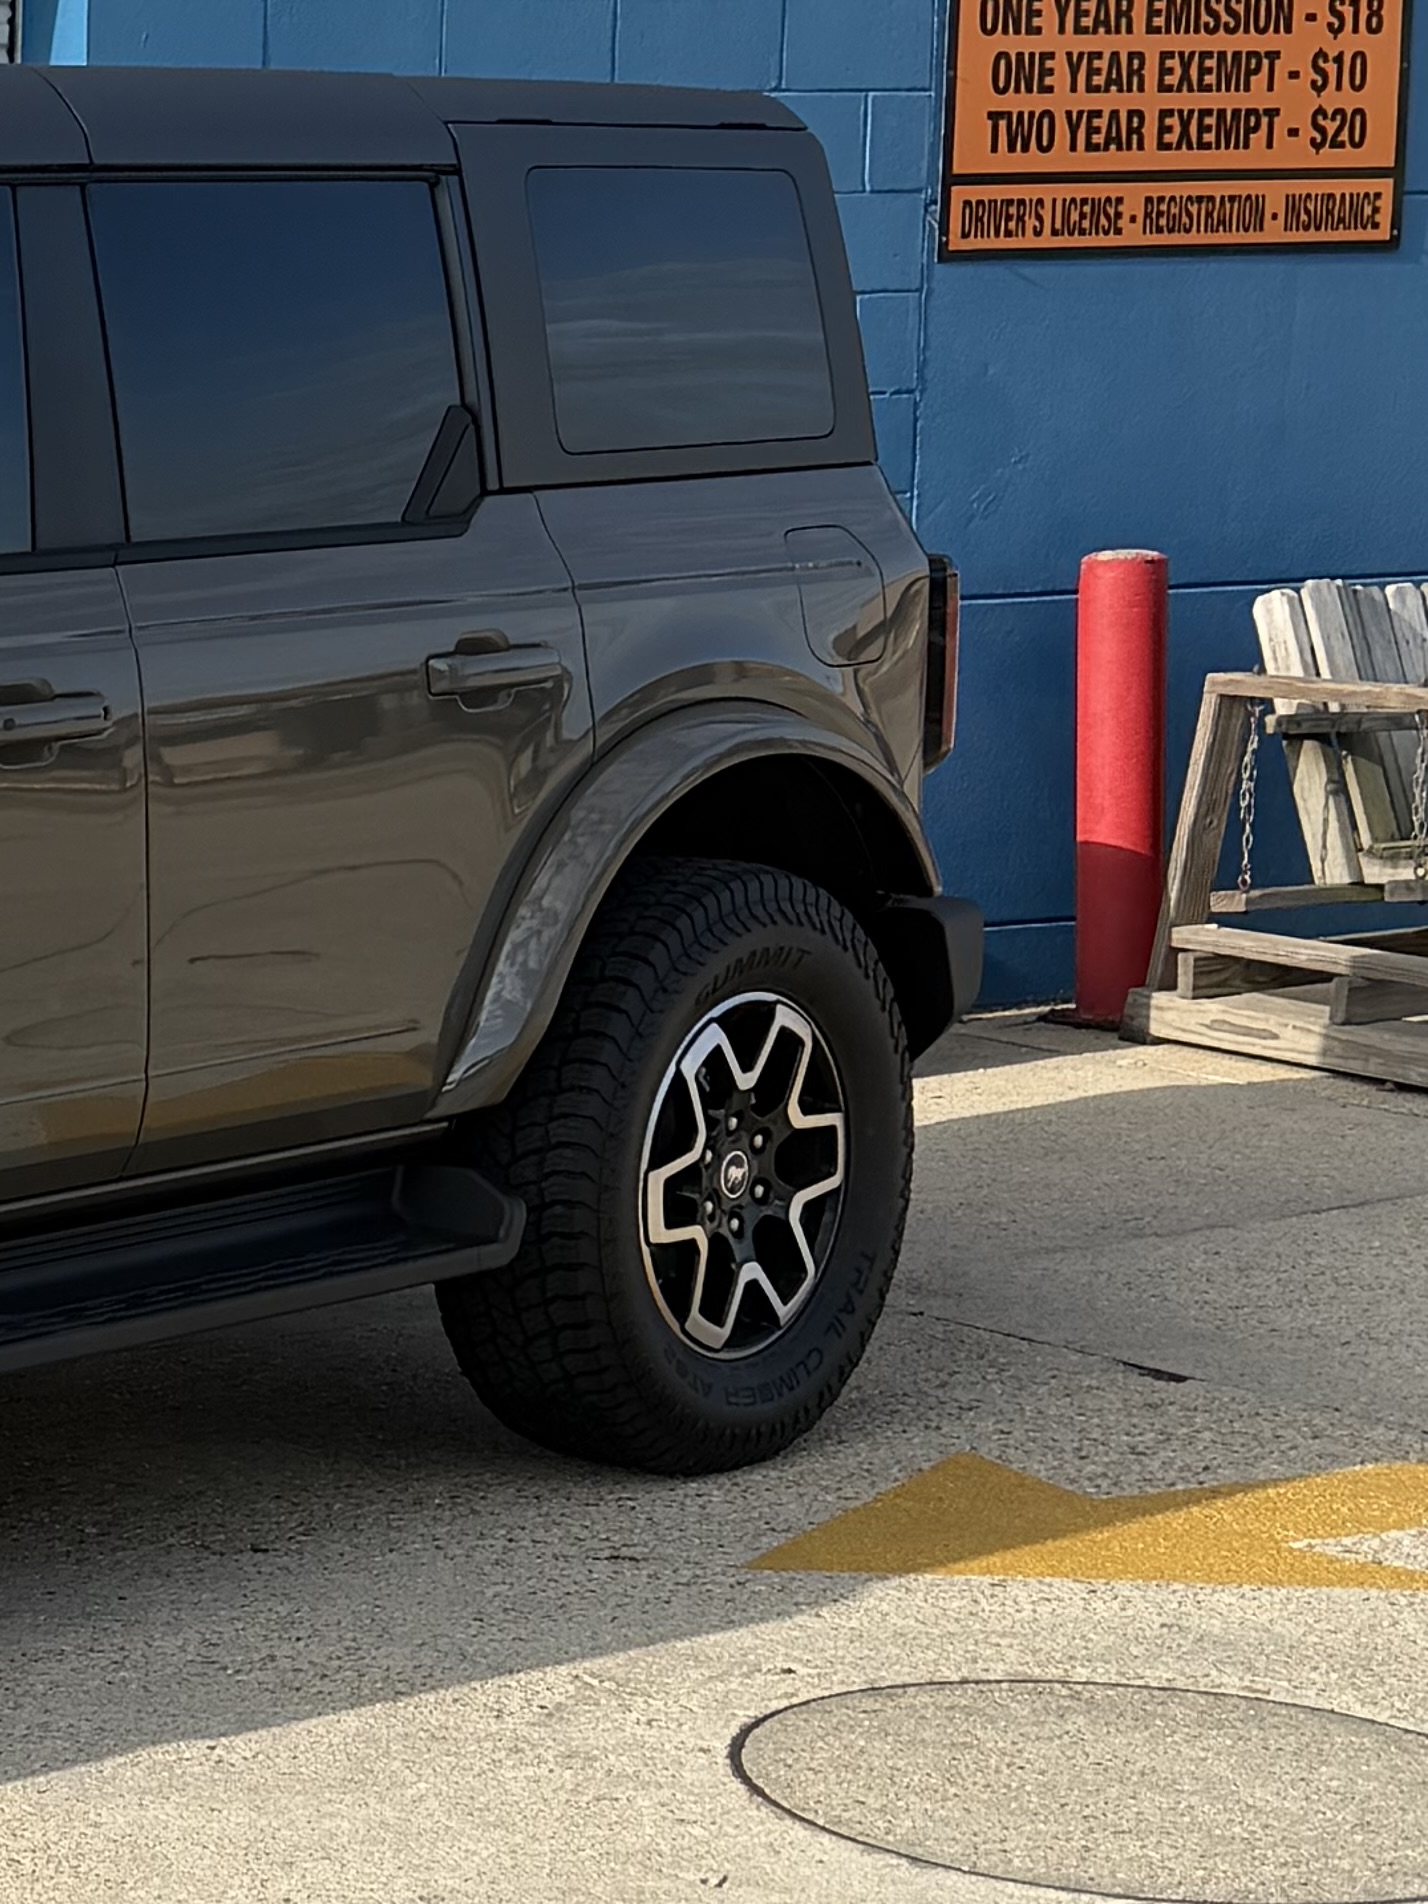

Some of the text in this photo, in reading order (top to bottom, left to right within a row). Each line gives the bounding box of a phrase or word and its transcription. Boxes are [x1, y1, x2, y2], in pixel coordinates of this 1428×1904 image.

[992, 51, 1055, 95] ONE
[1066, 51, 1145, 93] YEAR
[1157, 51, 1281, 93] EXEMPT
[1311, 48, 1367, 97] $10
[987, 109, 1055, 153] TWO
[1065, 109, 1145, 152] YEAR
[1157, 108, 1280, 151] EXEMPT
[1310, 105, 1366, 154] $20
[961, 198, 1044, 239] DRIVER'S
[1051, 196, 1124, 236] LICENSE
[1143, 194, 1265, 235] REGISTRATION
[1284, 192, 1382, 232] INSURANCE
[825, 1249, 878, 1338] TRAIL
